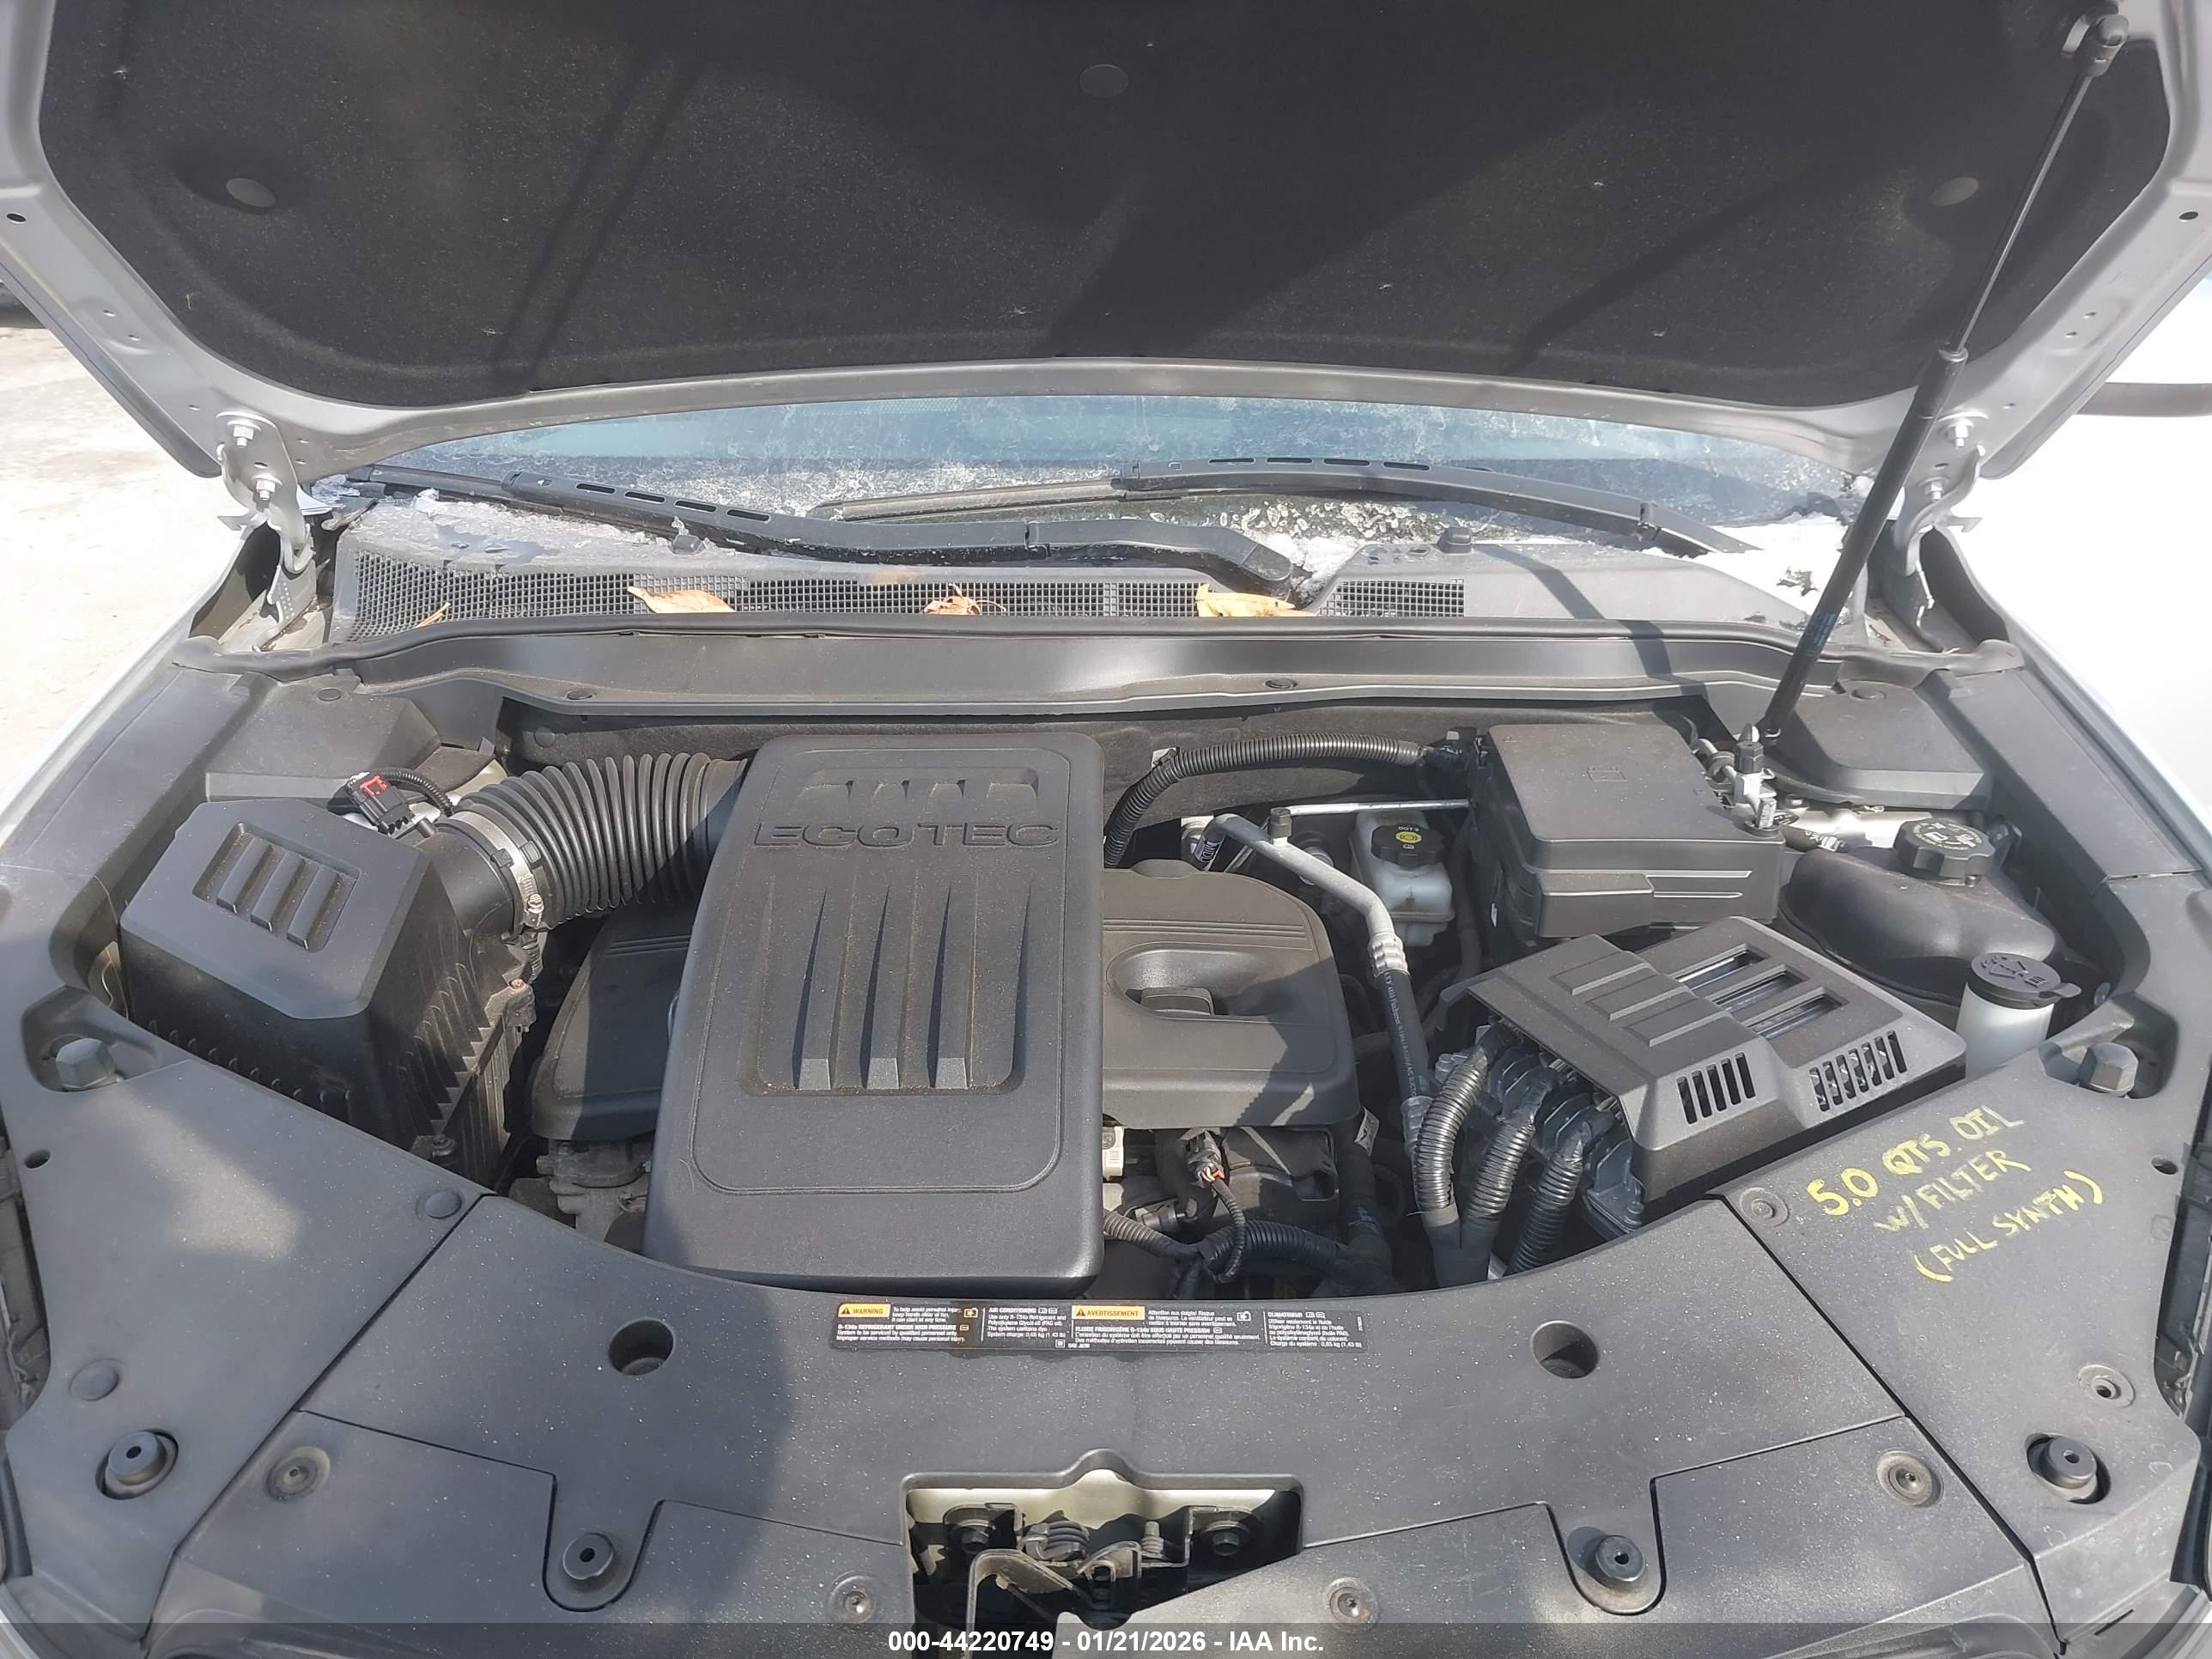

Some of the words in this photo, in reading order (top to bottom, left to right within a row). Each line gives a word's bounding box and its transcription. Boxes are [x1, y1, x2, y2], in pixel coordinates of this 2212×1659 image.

[753, 822, 1060, 848] ECOTEC
[1807, 1166, 1880, 1217] 5.0
[1948, 1104, 2027, 1140] OIL
[1911, 1231, 1999, 1282] (FULL
[1991, 1170, 2104, 1237] SYNTH)
